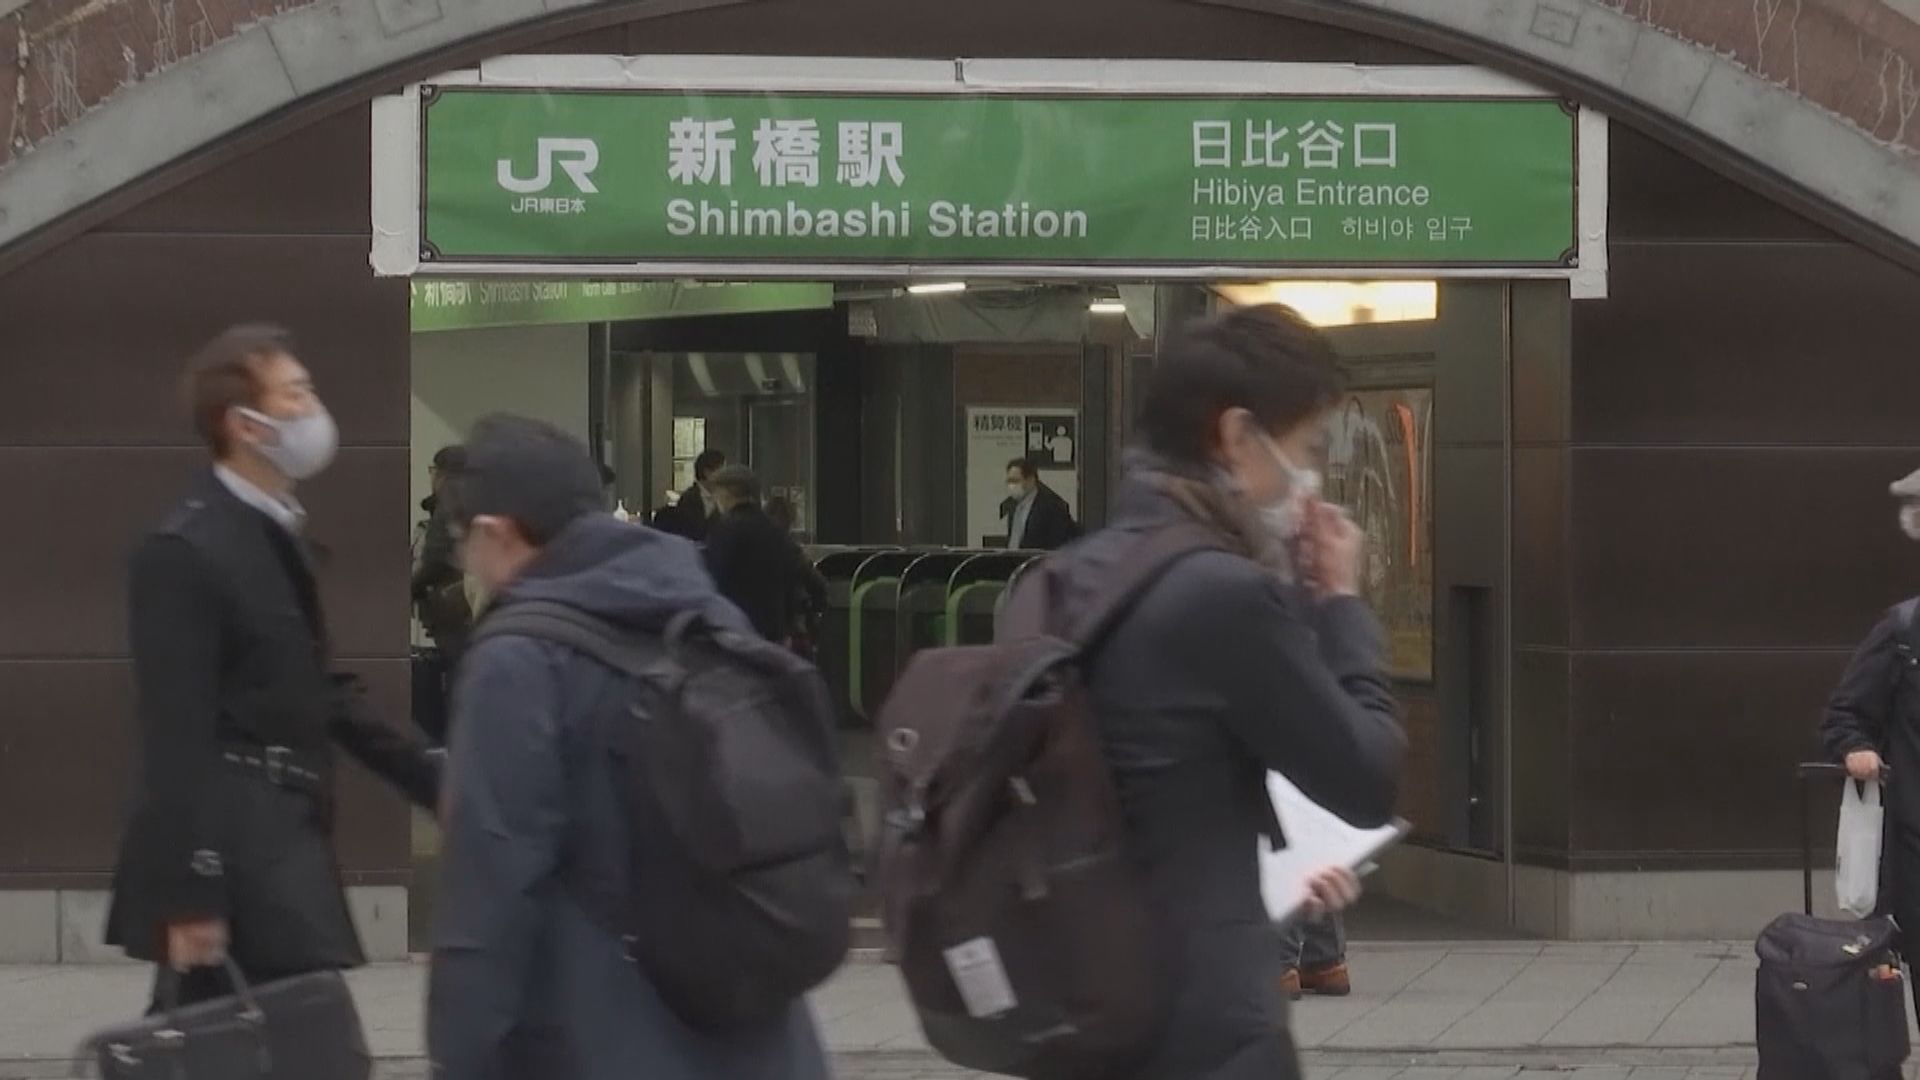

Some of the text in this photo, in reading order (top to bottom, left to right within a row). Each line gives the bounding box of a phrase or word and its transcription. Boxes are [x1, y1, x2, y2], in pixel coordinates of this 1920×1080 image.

[667, 117, 905, 188] 新橋駅
[1192, 119, 1398, 169] 日比谷口
[497, 138, 599, 193] JR
[511, 197, 586, 214] JR東日本
[1193, 179, 1430, 211] Hibiya Entrance
[666, 199, 1088, 237] Shimbashi Station
[1191, 215, 1312, 241] 日比谷入口
[1341, 215, 1473, 242] 히비야 입구
